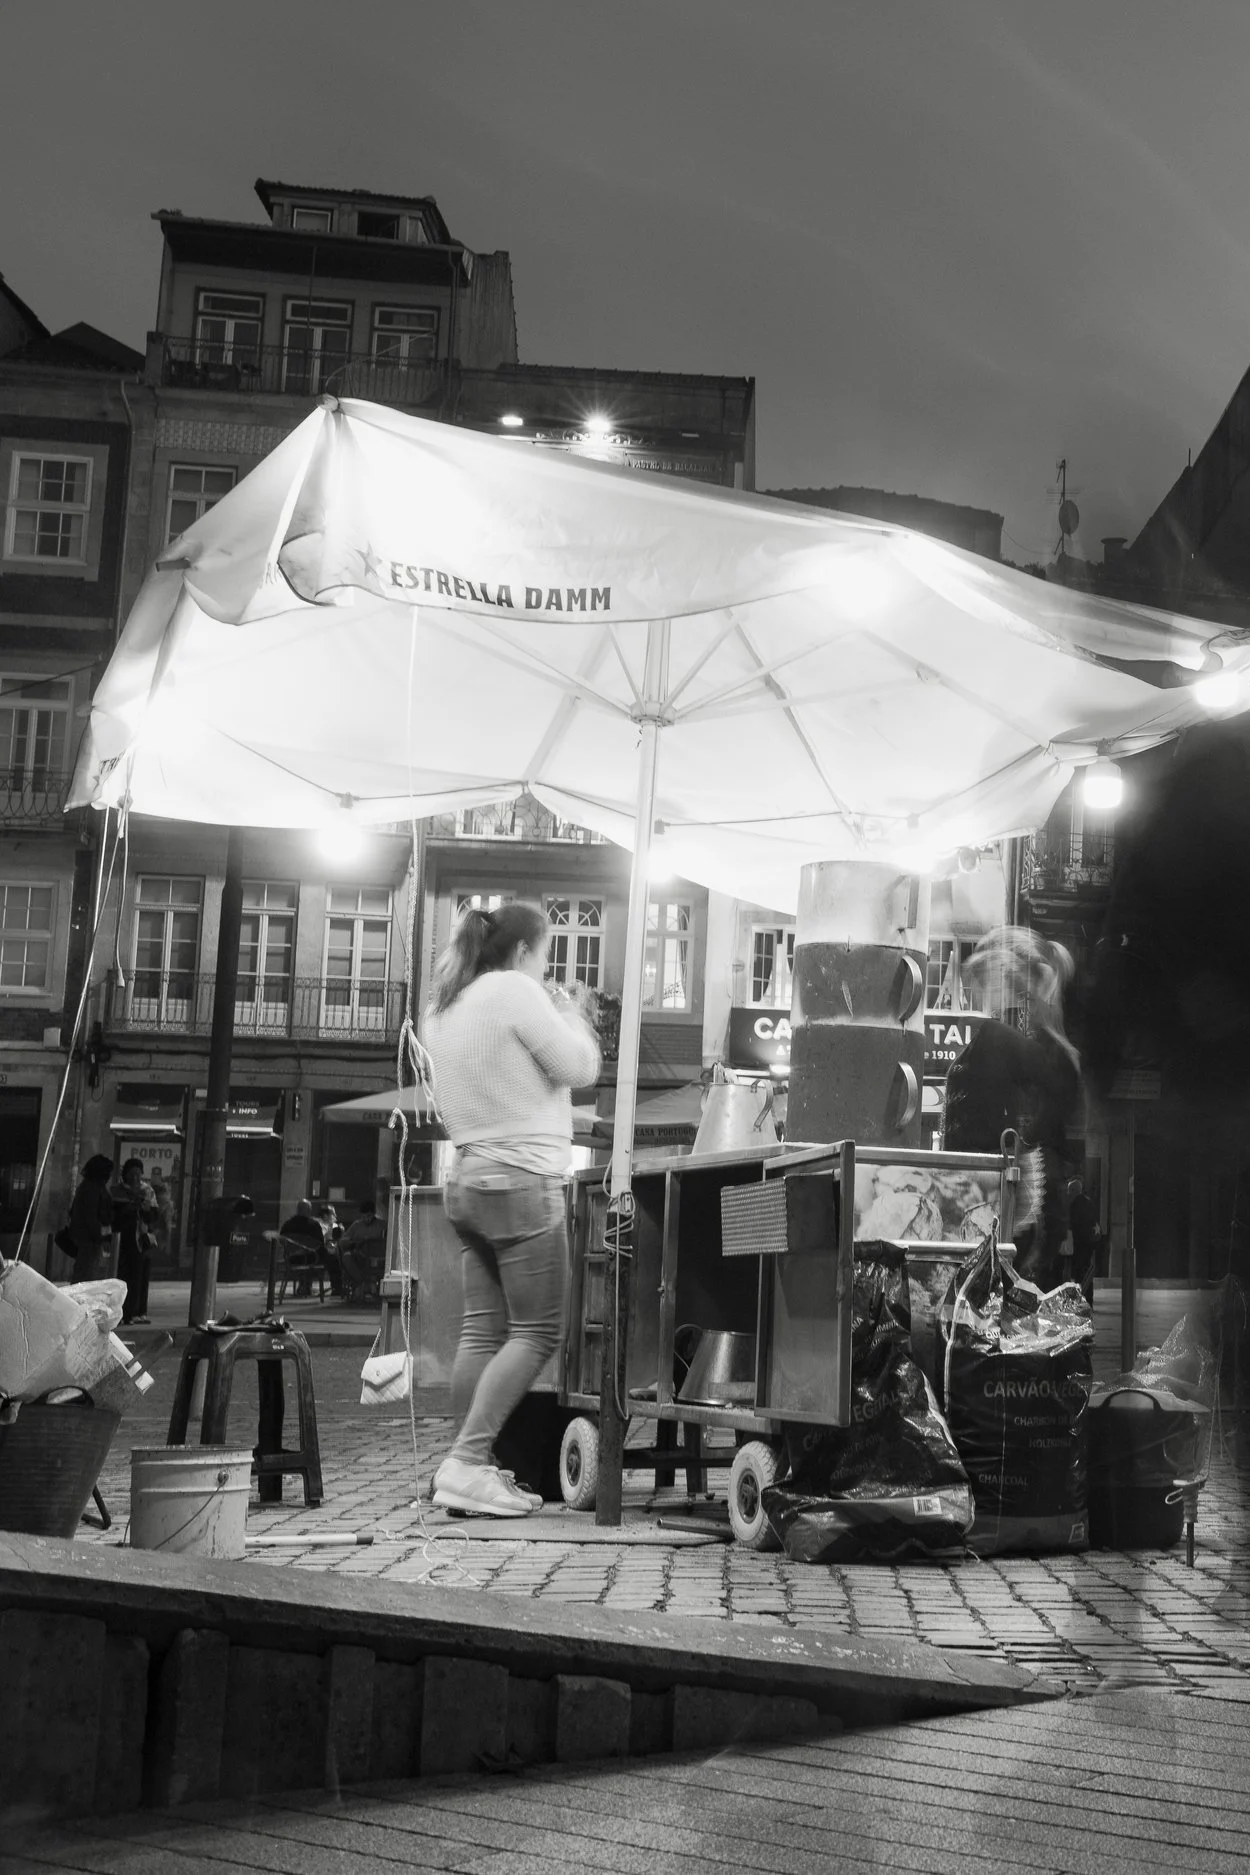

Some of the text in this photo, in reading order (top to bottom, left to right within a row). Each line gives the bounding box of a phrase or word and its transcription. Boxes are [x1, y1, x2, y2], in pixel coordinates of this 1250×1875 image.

[390, 561, 612, 612] ESTRELLA DAMM
[753, 1016, 793, 1041] CA
[931, 1050, 957, 1061] 1910
[238, 1107, 258, 1115] INFO
[635, 1127, 655, 1137] CASA
[130, 1147, 173, 1159] PORTO
[983, 1376, 1050, 1398] CARVÃO
[852, 1391, 900, 1423] EGETAL
[978, 1473, 1029, 1488] CHARCOAL
